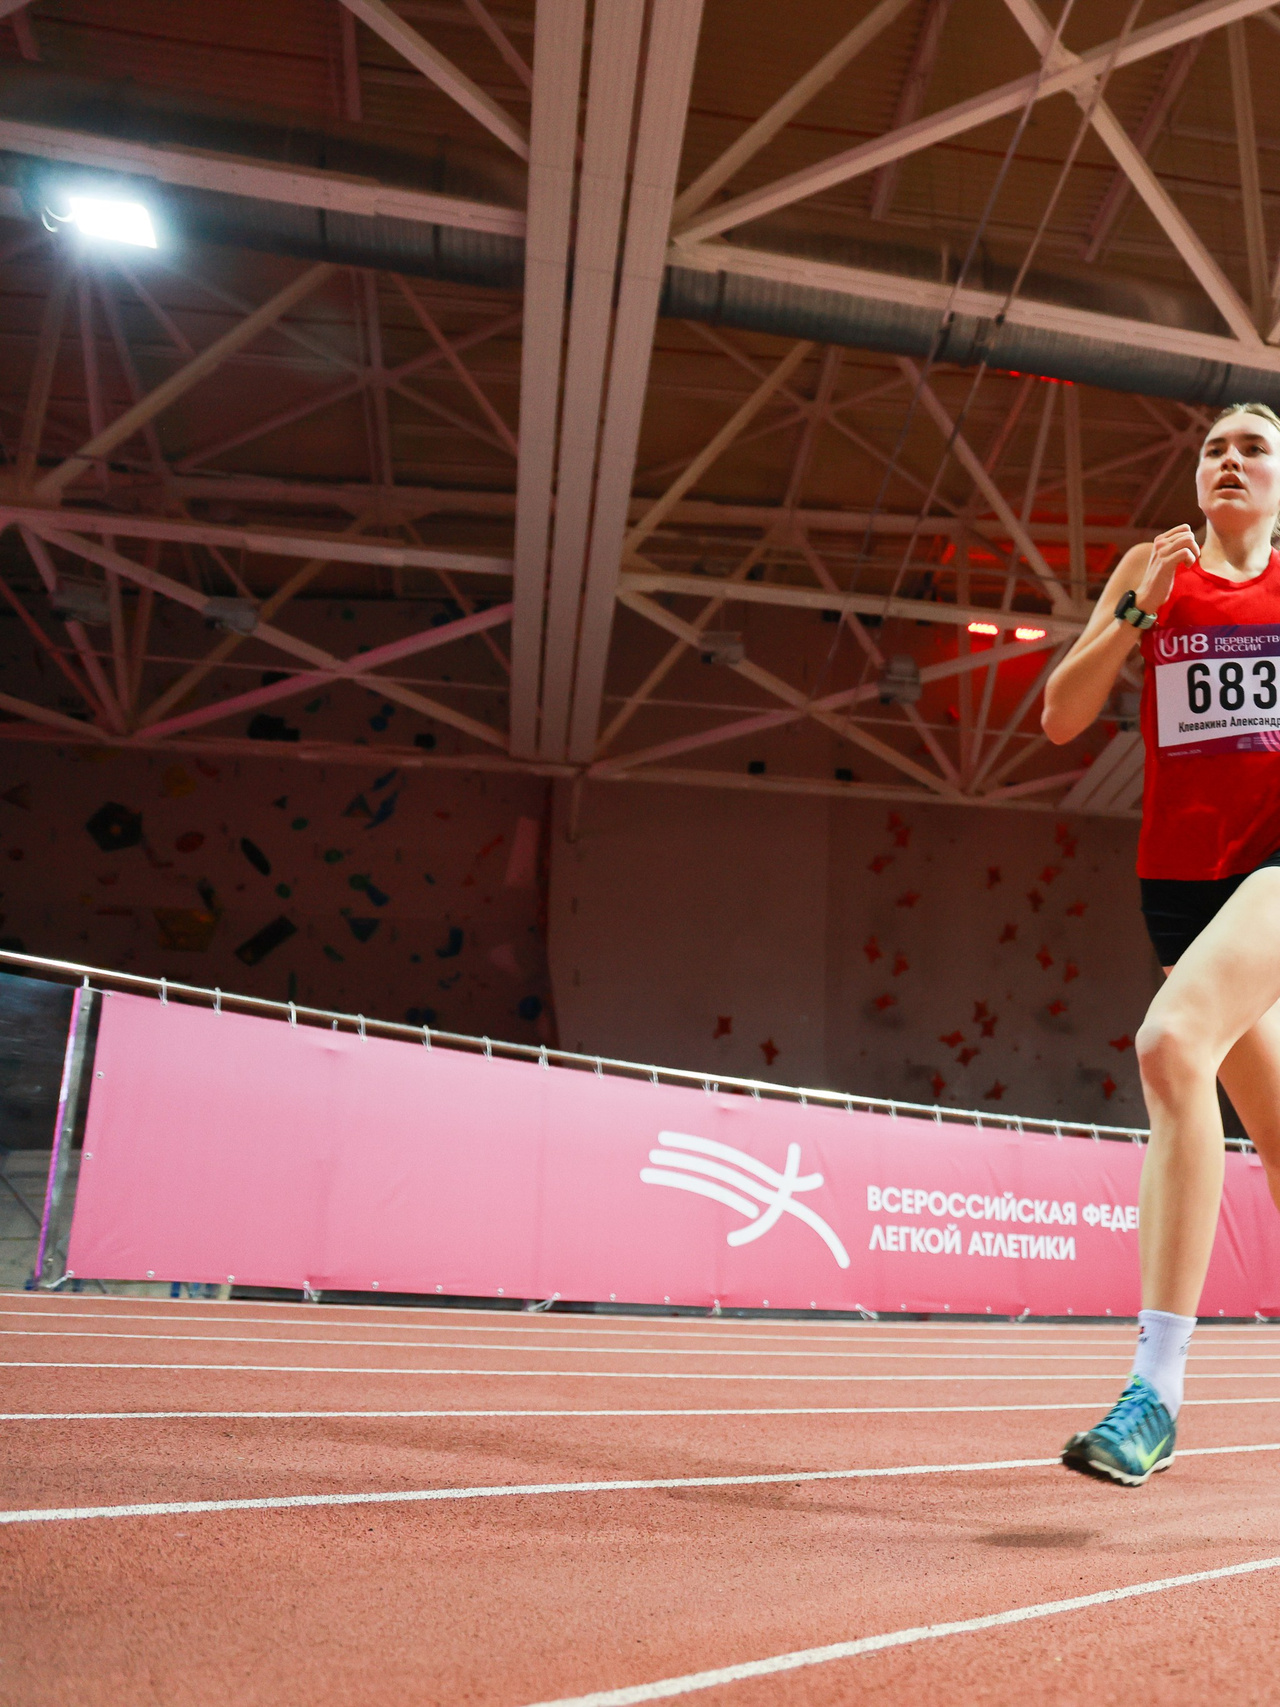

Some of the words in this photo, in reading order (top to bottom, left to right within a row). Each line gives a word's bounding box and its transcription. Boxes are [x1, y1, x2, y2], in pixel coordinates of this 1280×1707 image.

[1160, 633, 1209, 657] U18
[1214, 644, 1262, 653] РОССИИ
[1187, 660, 1277, 713] 683
[1178, 718, 1227, 733] Клевакина
[866, 1184, 1078, 1227] ВСЕРОССИЙСКАЯ
[868, 1224, 962, 1255] ЛЕГКОЙ
[967, 1234, 1077, 1262] АТЛЕТИКИ
